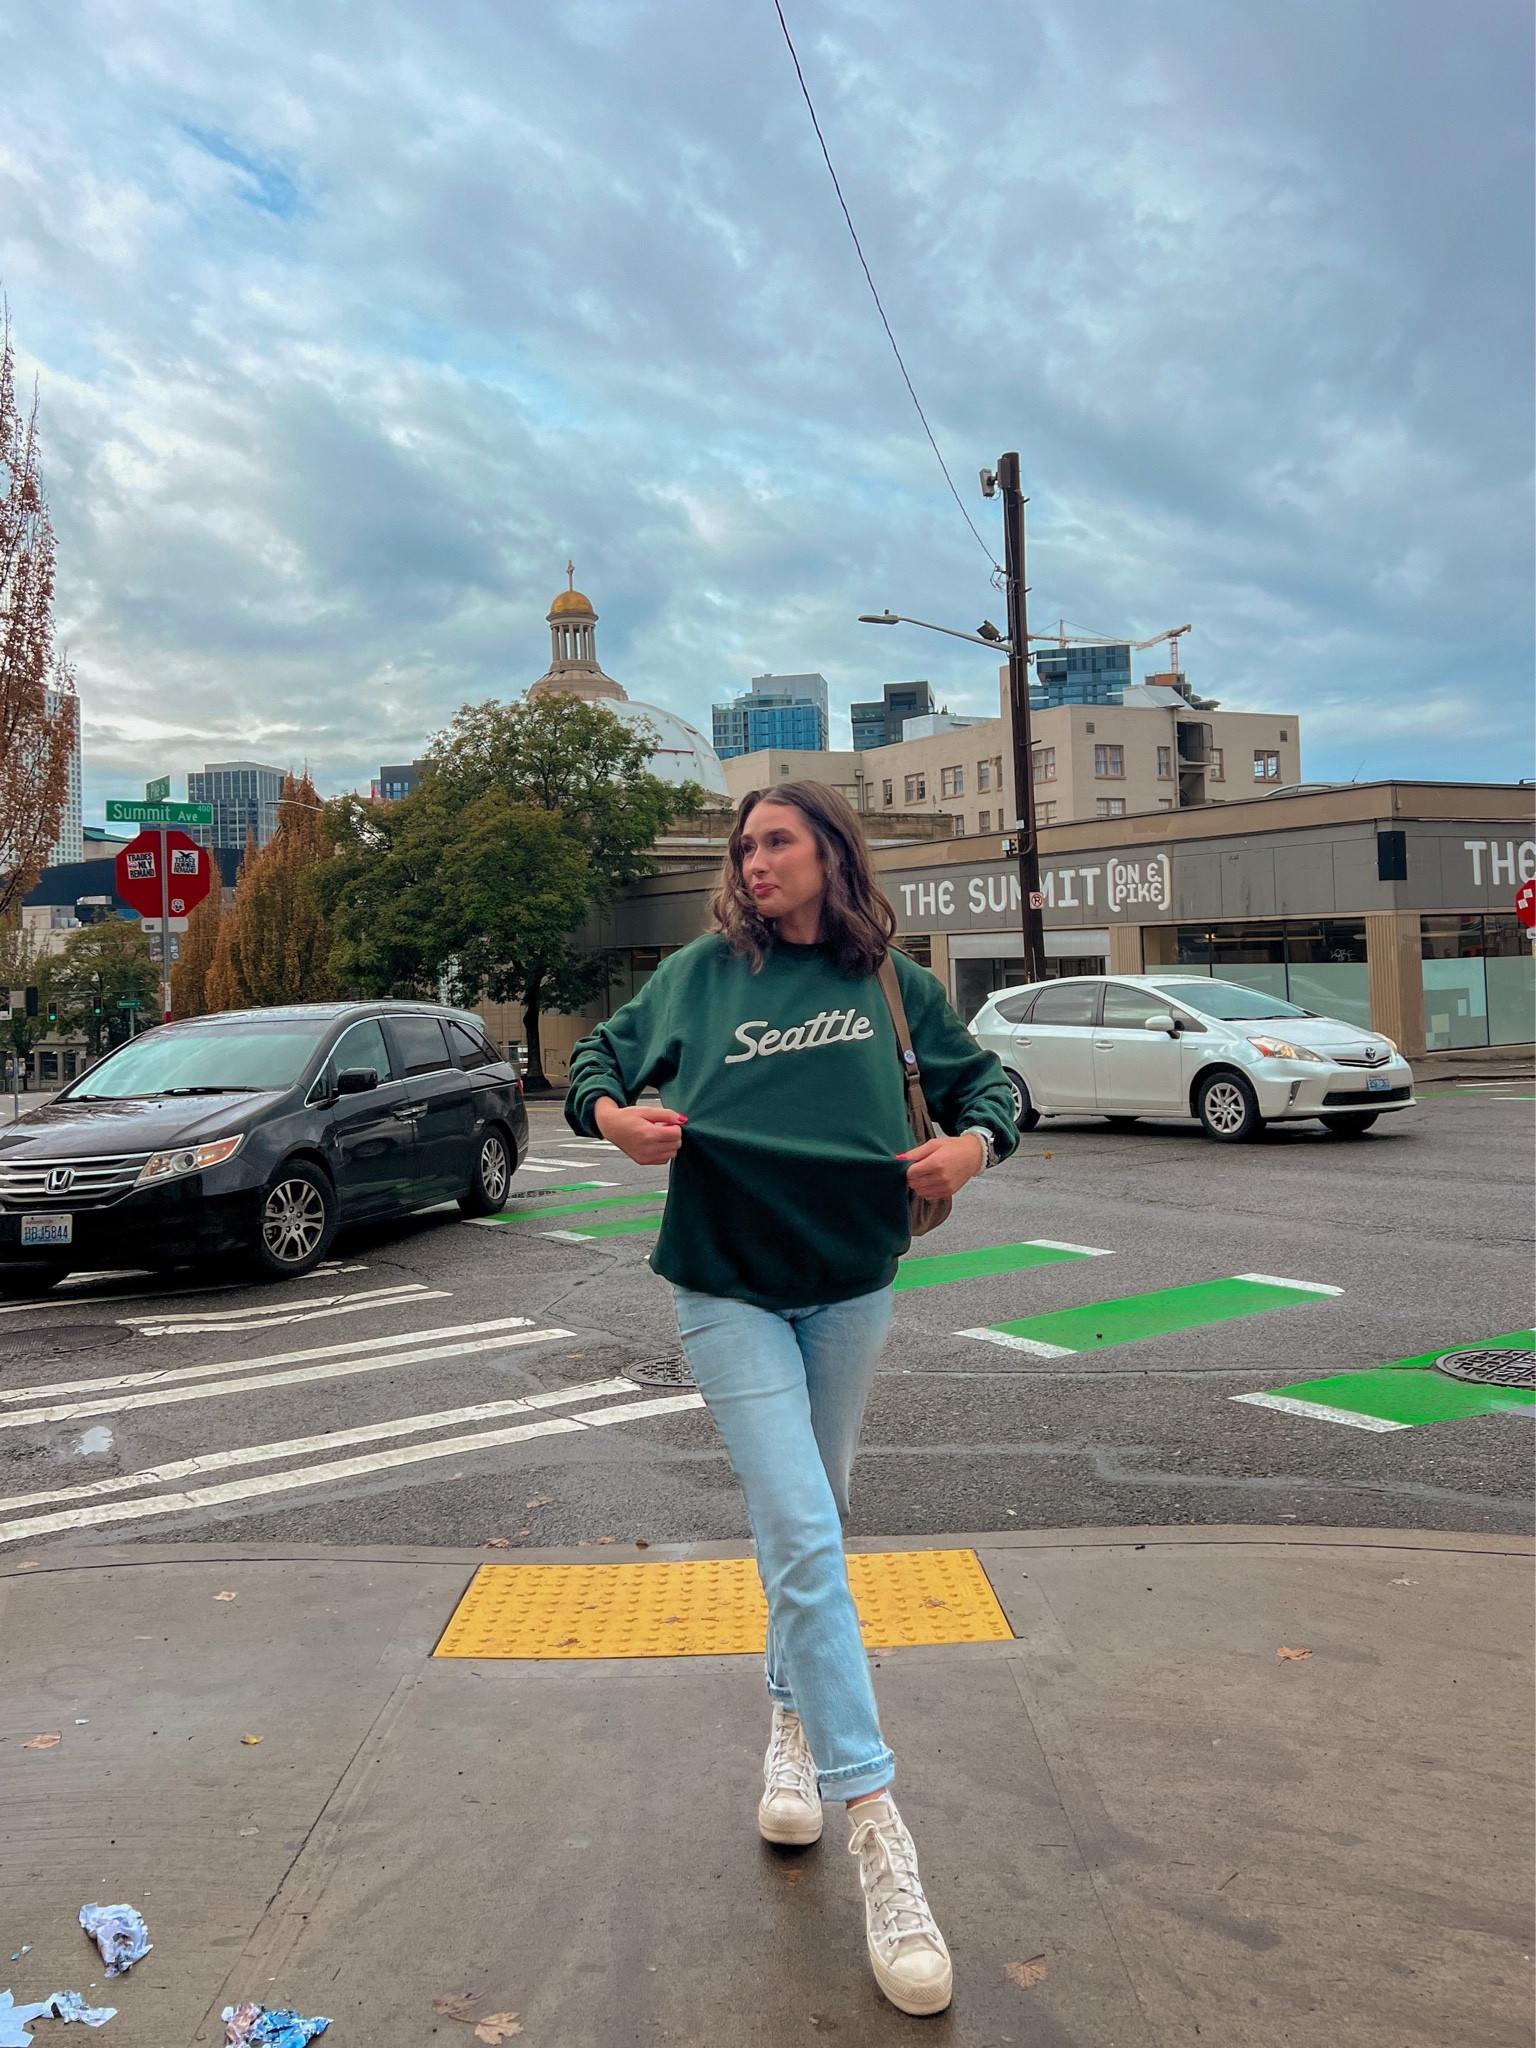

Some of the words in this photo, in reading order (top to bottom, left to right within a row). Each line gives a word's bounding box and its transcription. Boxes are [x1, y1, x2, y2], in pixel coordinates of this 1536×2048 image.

[112, 803, 171, 821] Summit
[177, 811, 198, 822] Ave
[197, 805, 211, 813] 400
[1463, 840, 1536, 886] THE
[900, 880, 955, 917] THE
[1115, 882, 1163, 904] PIKE
[724, 1008, 875, 1064] Seattle
